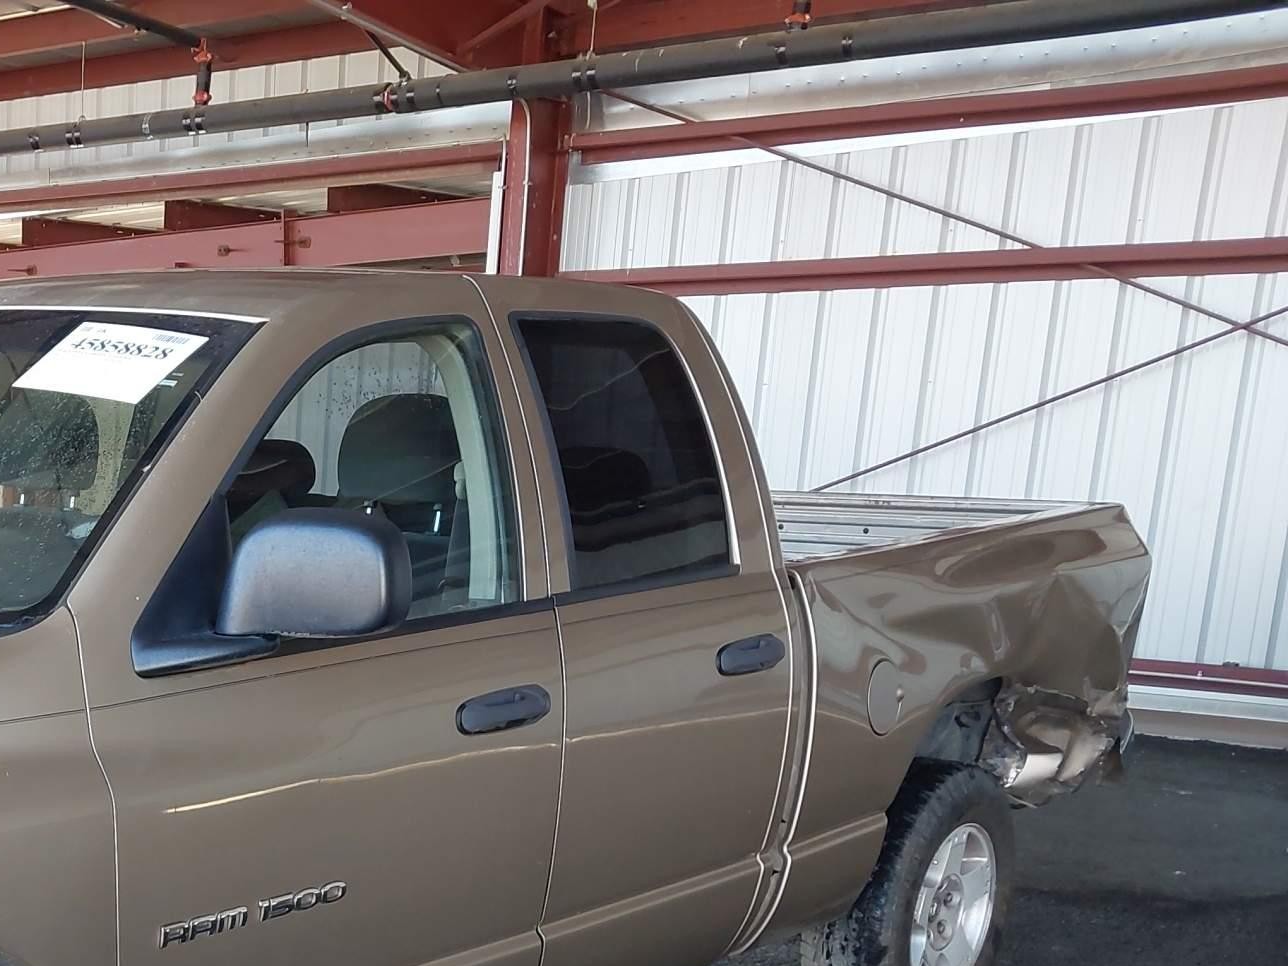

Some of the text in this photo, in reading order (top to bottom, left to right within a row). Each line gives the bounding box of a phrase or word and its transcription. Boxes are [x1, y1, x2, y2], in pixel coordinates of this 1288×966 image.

[72, 338, 174, 360] 45858828
[159, 880, 347, 950] RAM 1500
